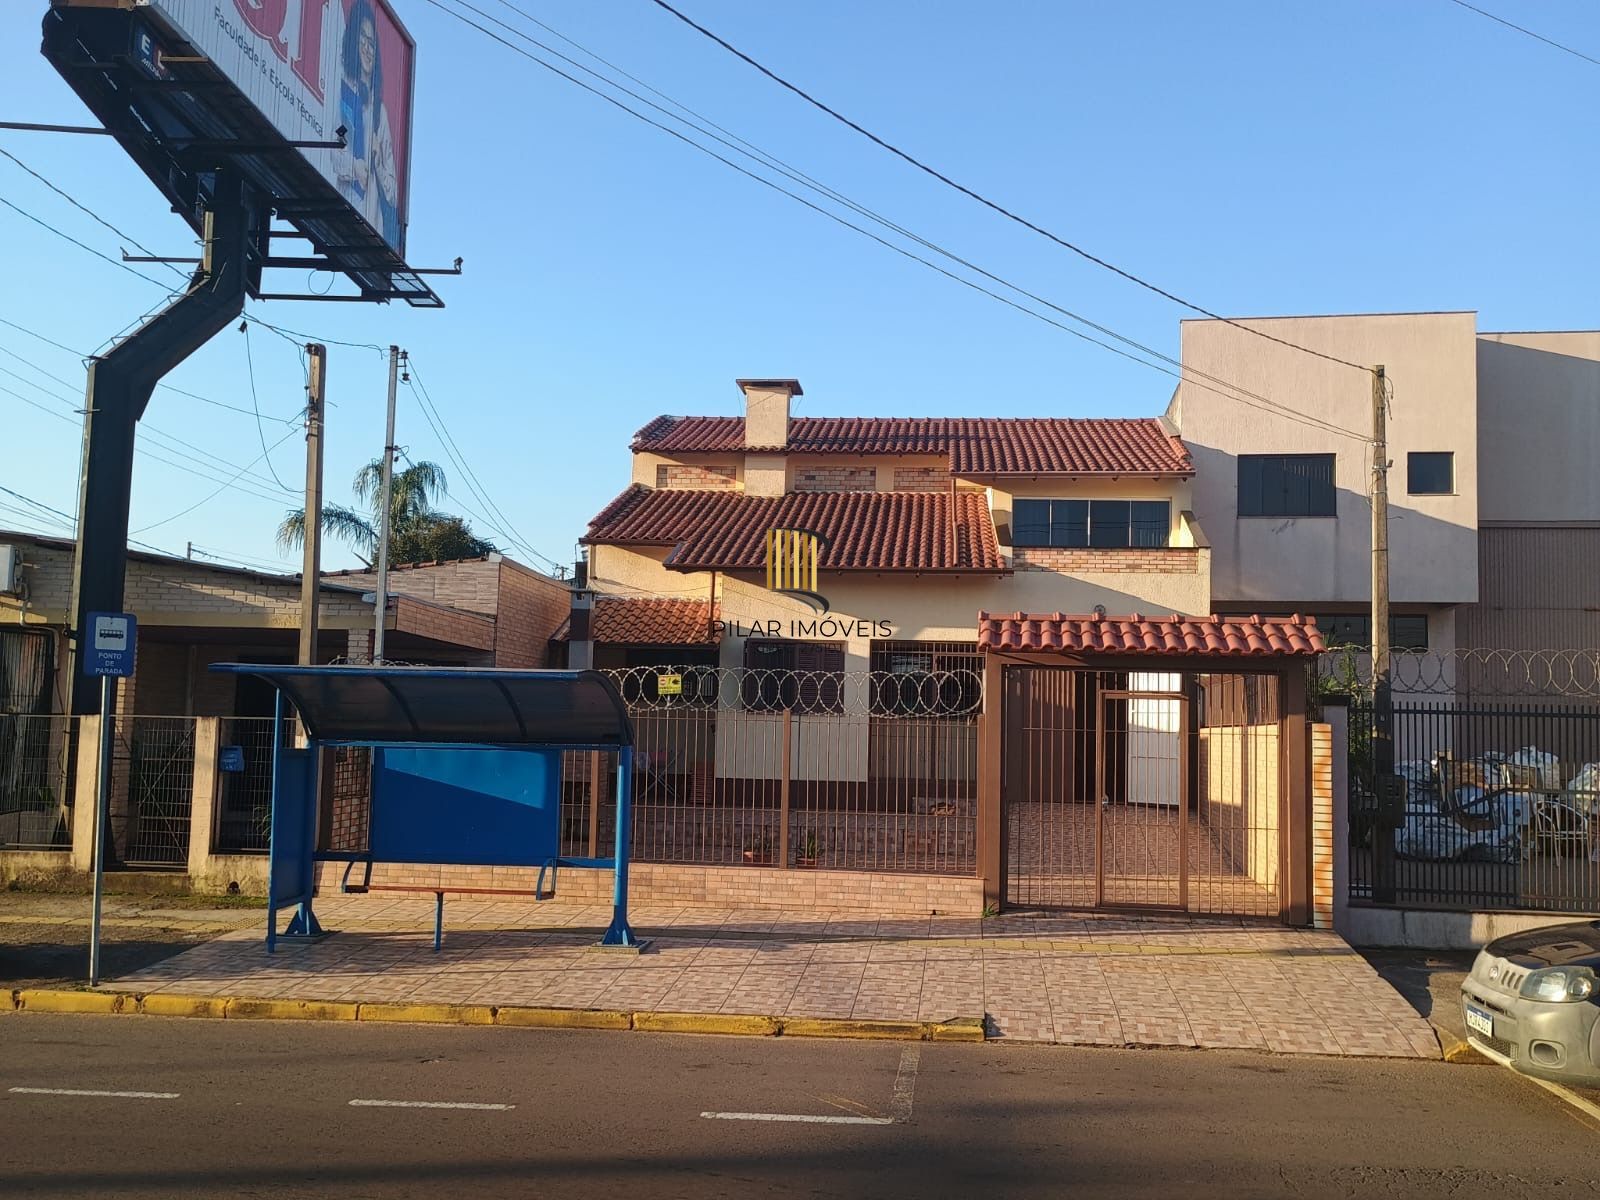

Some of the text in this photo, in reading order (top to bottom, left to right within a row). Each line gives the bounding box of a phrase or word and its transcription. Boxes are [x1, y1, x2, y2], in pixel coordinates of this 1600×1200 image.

[214, 6, 323, 137] Faculdade & Escola Técnica
[98, 652, 122, 660] PONTO
[95, 666, 123, 674] PARADA
